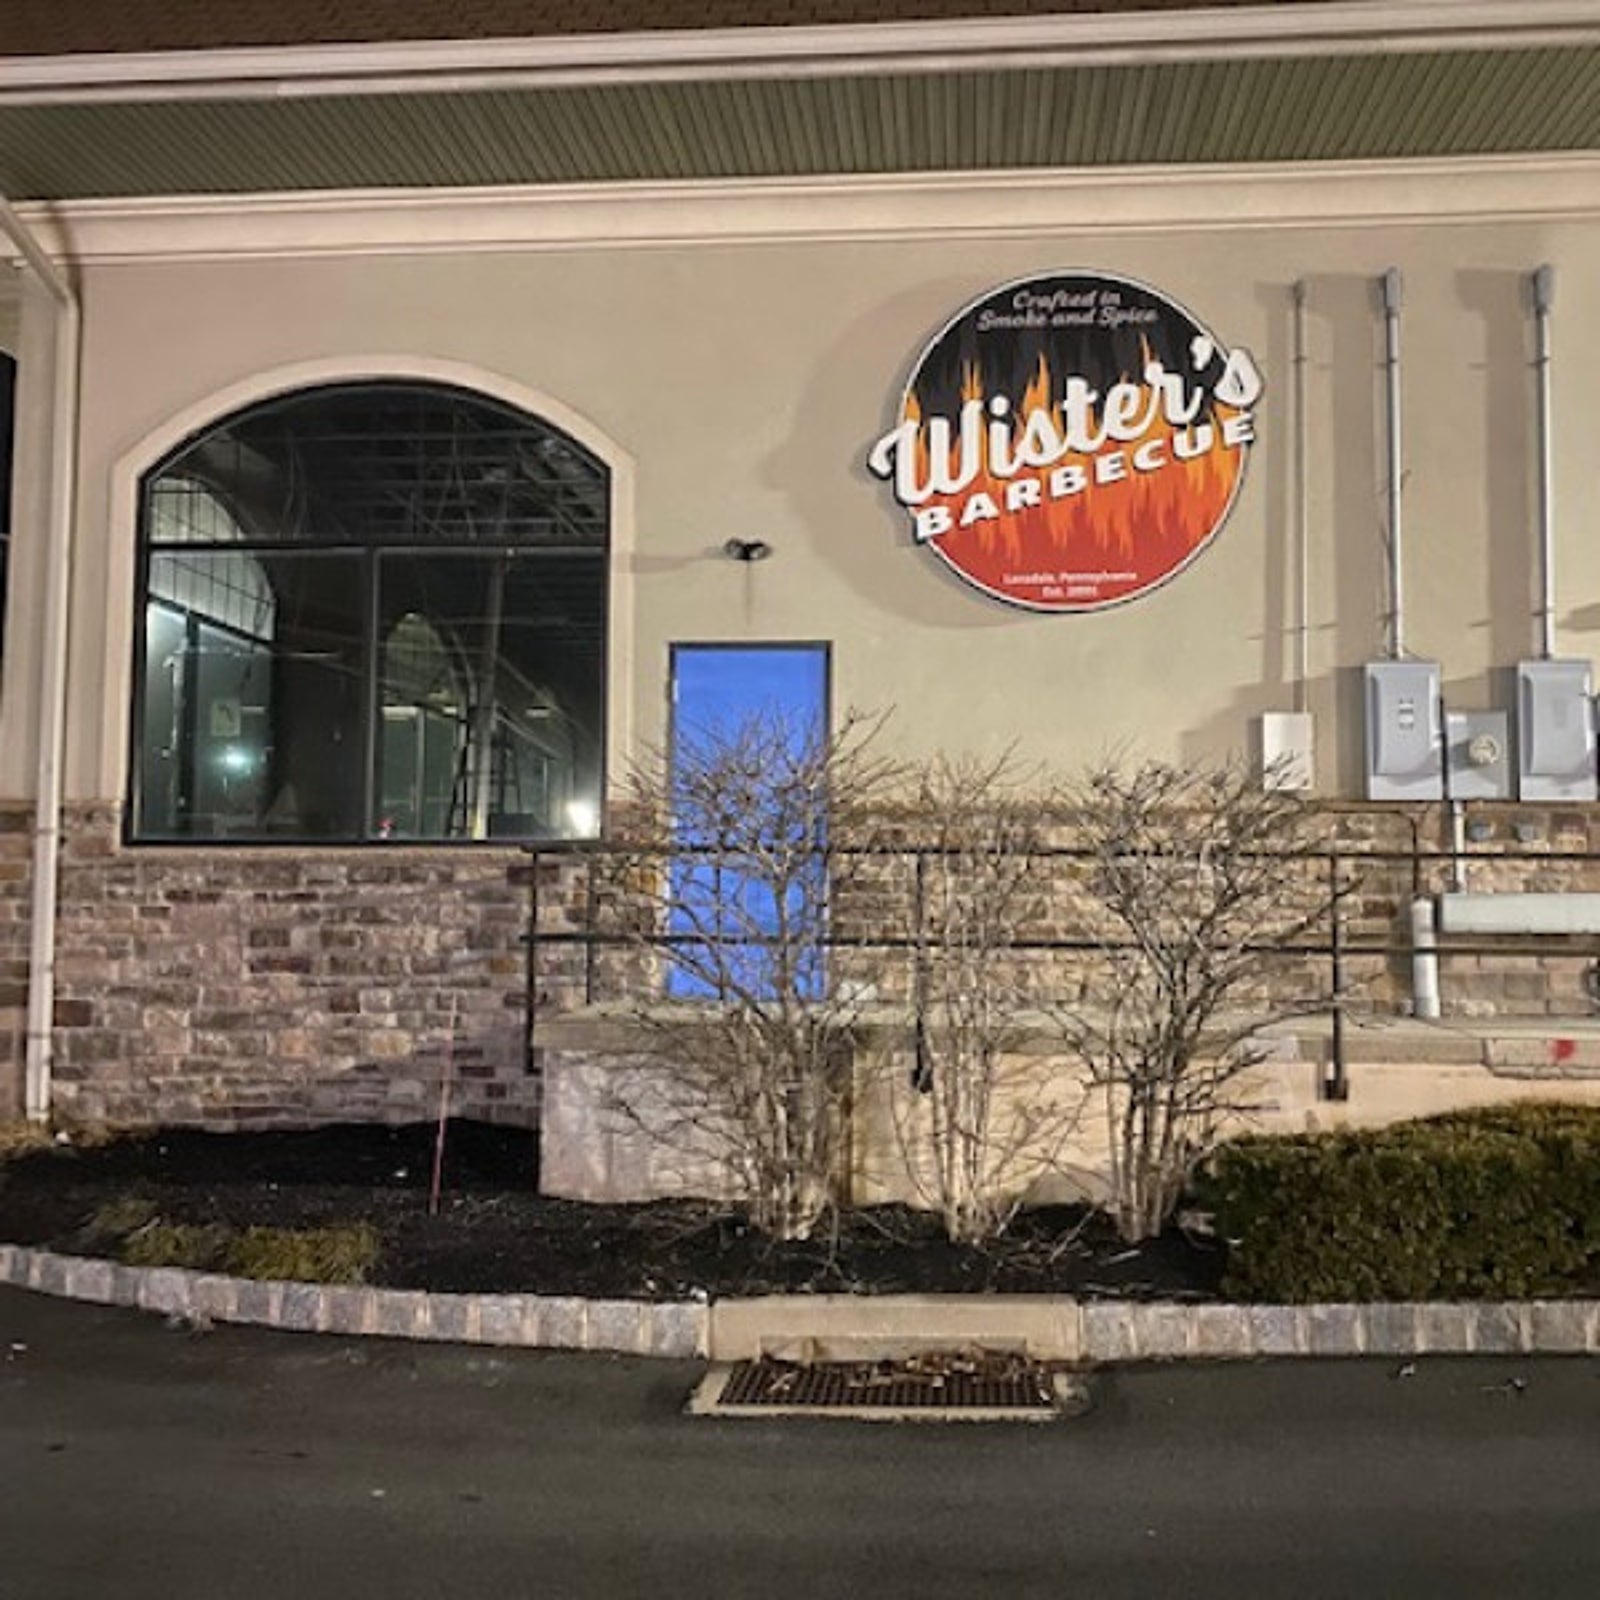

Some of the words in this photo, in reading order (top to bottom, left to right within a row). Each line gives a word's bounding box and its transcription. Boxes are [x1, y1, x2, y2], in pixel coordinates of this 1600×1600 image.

[976, 310, 1047, 331] Smoke
[1052, 308, 1096, 326] and
[1100, 306, 1157, 328] Spice
[1013, 290, 1098, 311] Crafted
[1101, 291, 1121, 306] in
[868, 335, 1263, 505] Wister's
[915, 412, 1255, 539] BARBECUE
